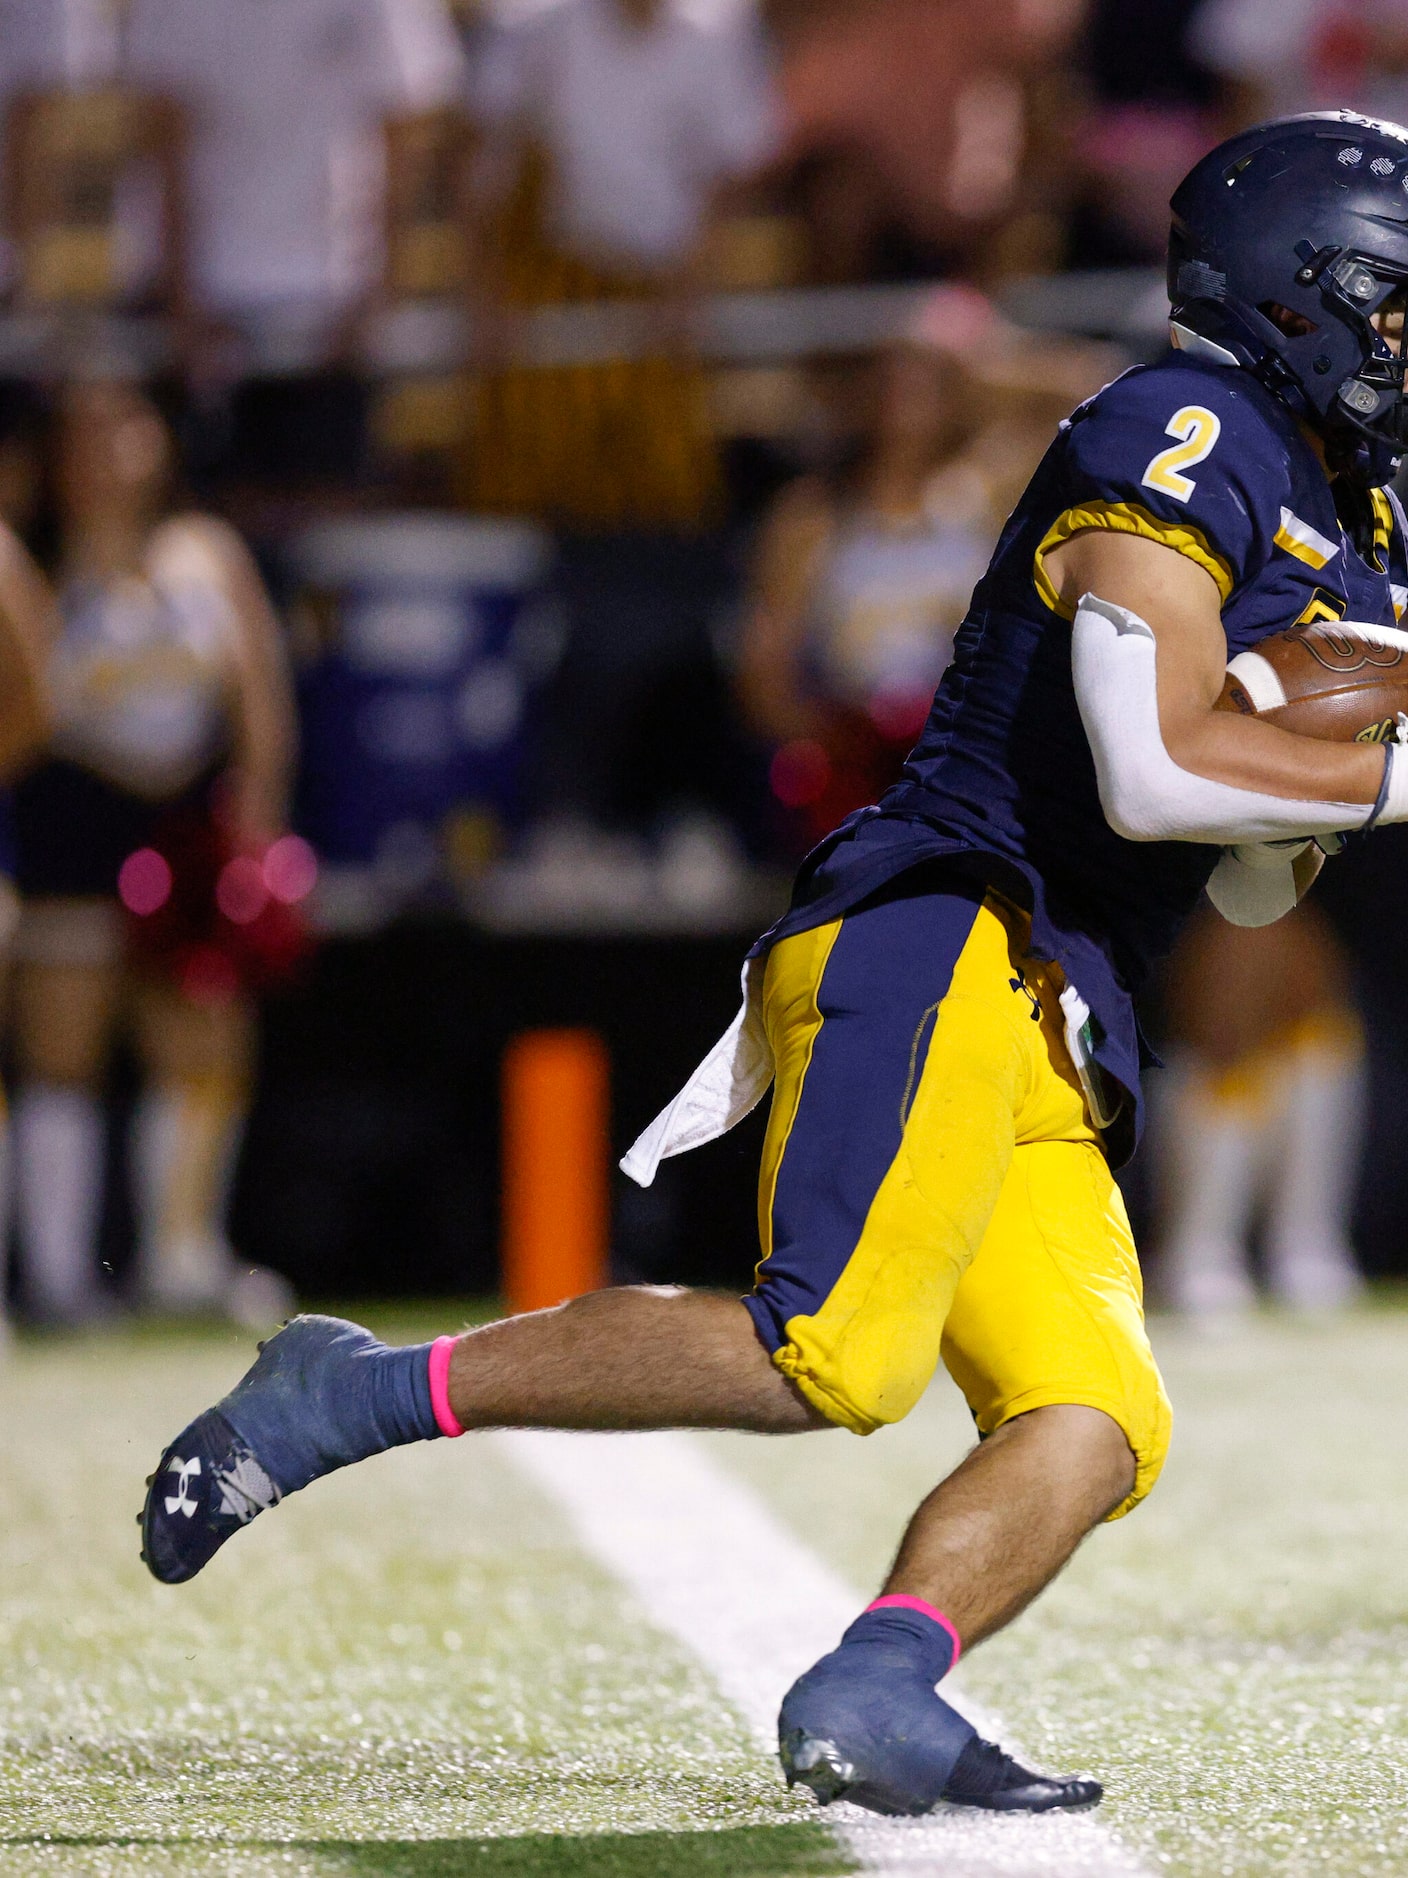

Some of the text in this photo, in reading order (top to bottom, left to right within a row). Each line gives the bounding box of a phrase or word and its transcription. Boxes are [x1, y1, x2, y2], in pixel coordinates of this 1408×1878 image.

[1337, 146, 1363, 167] PRIDE
[1369, 157, 1396, 176] PRIDE
[1141, 405, 1221, 504] 2
